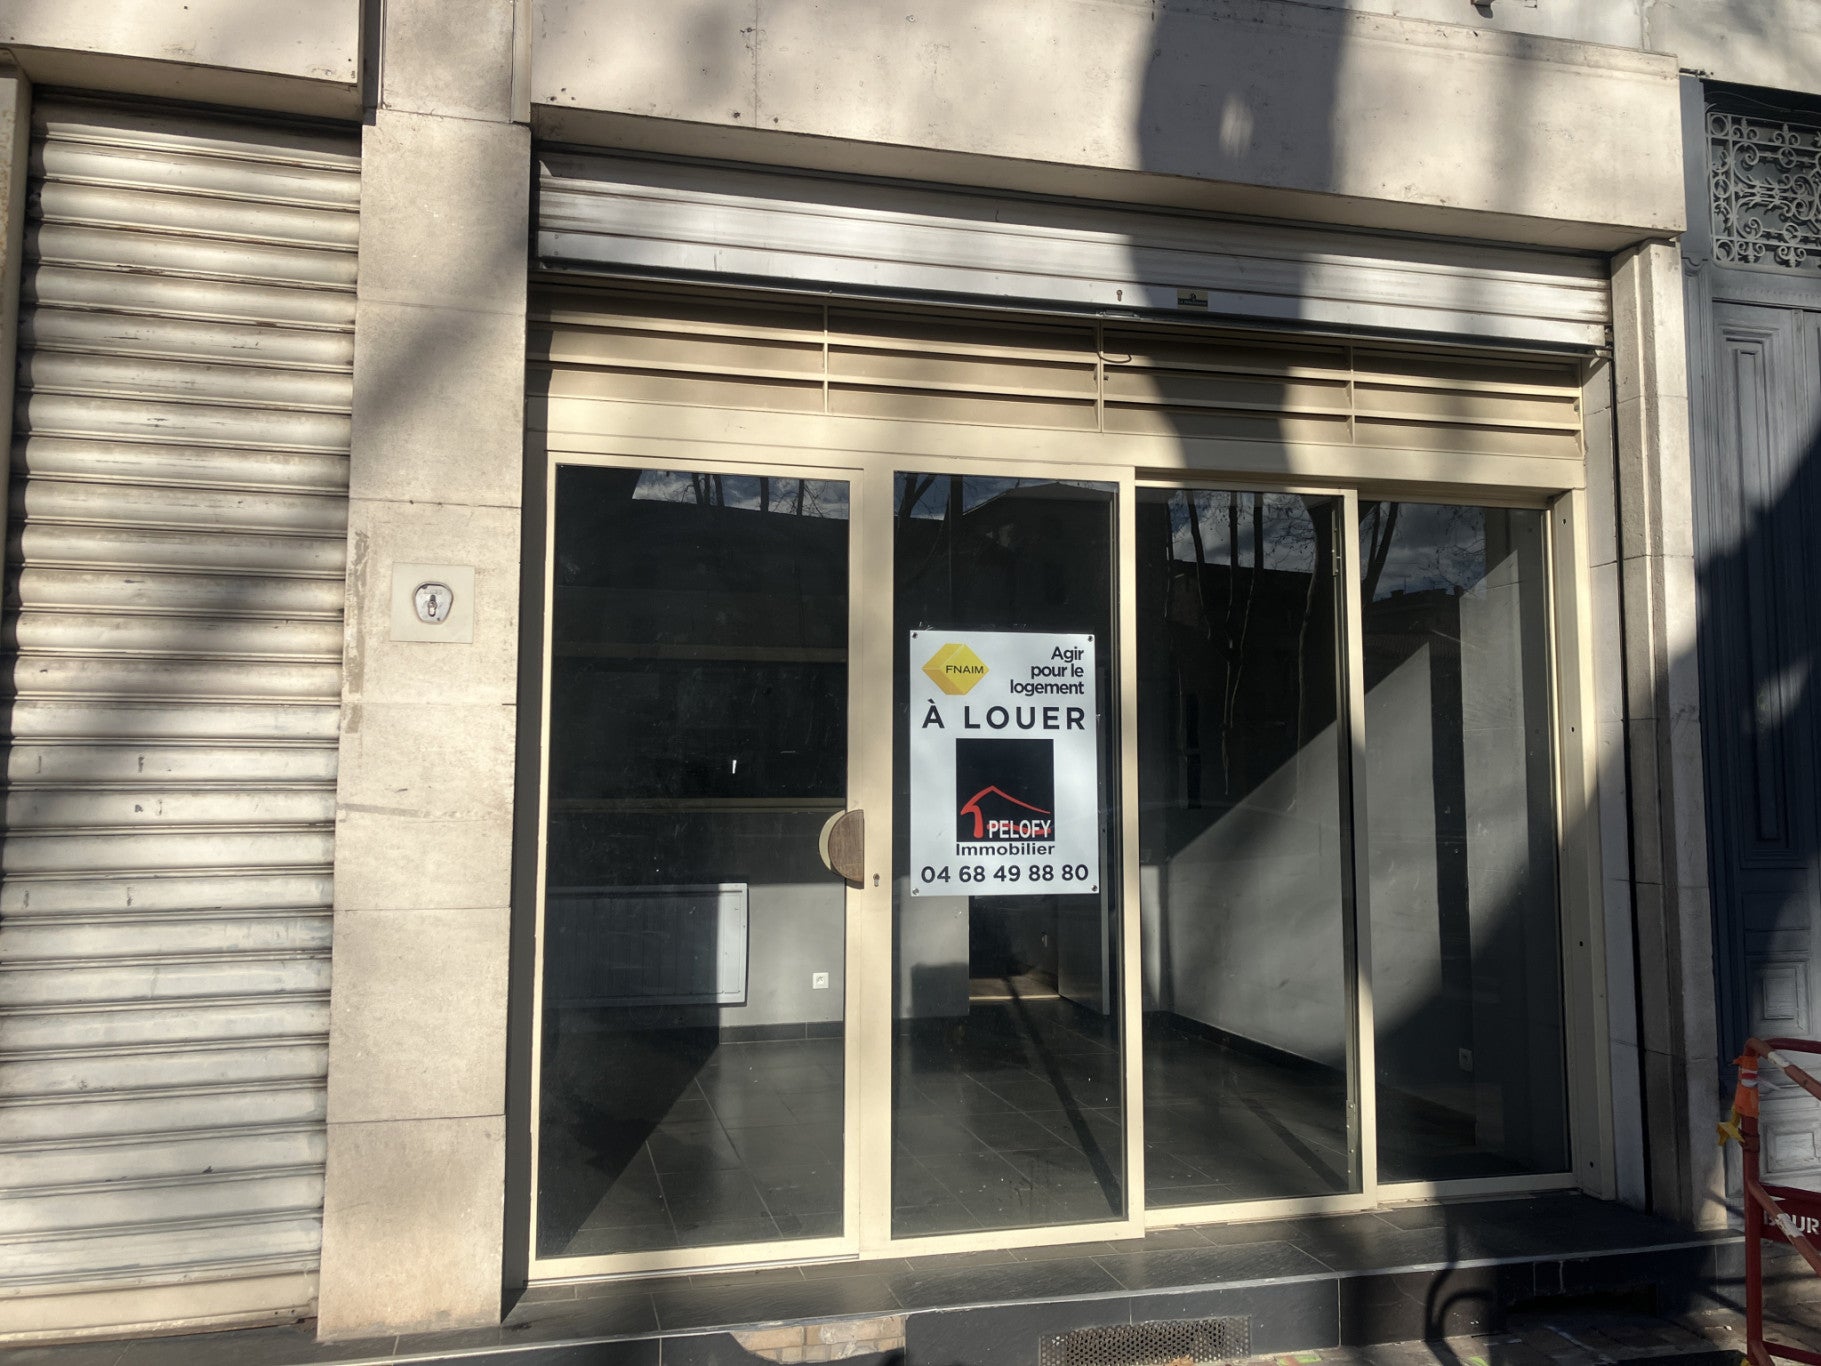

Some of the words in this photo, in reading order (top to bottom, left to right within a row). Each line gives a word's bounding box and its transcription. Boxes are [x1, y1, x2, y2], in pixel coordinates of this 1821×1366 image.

[1051, 646, 1084, 663] Agir
[945, 665, 984, 674] FNAIM
[1031, 665, 1068, 679] pour
[1071, 663, 1084, 677] le
[1010, 679, 1085, 697] logement
[922, 698, 945, 729] À
[964, 705, 1086, 730] LOUER
[988, 819, 1052, 839] PELOFY
[956, 843, 1055, 856] Immobilier
[921, 866, 951, 884] 04
[958, 865, 986, 883] 68
[993, 865, 1021, 882] 49
[1028, 864, 1054, 882] 88
[1061, 864, 1089, 882] 80
